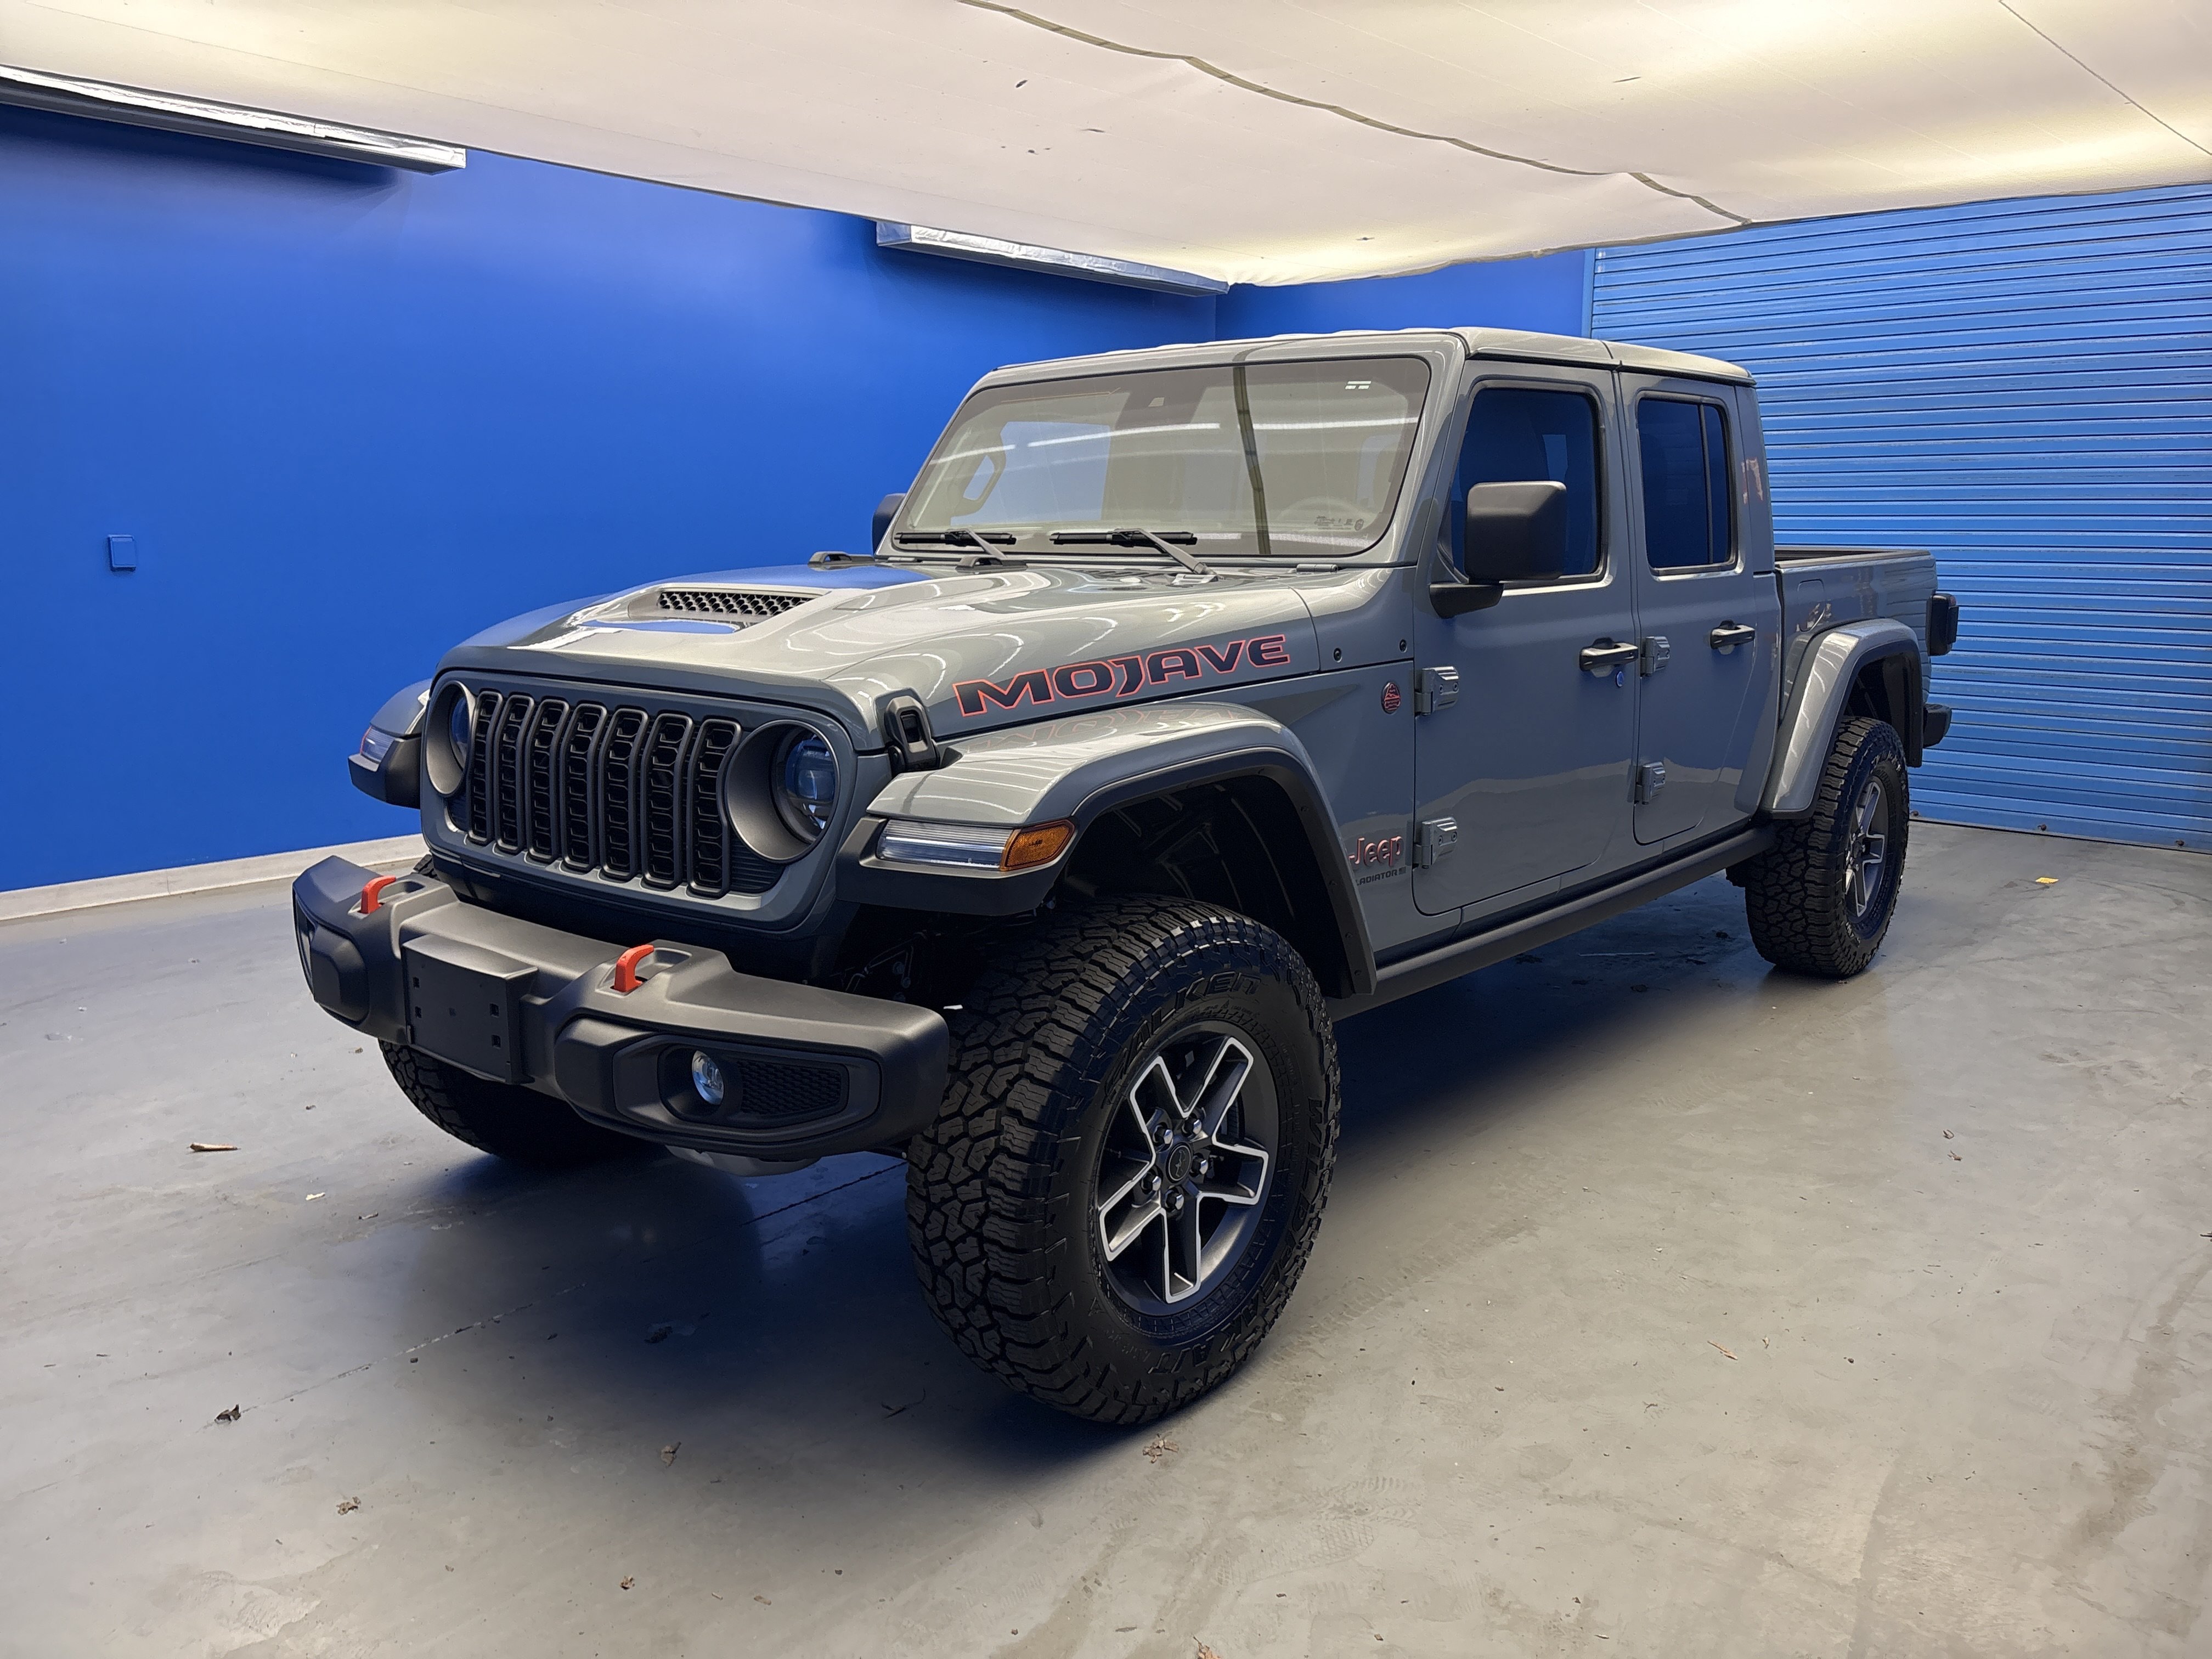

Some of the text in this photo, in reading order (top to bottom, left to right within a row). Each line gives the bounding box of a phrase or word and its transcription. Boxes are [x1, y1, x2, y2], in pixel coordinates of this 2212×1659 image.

[952, 634, 1290, 716] MOJAVE
[1348, 836, 1404, 867] Jeep
[1355, 868, 1397, 886] ADIATOR
